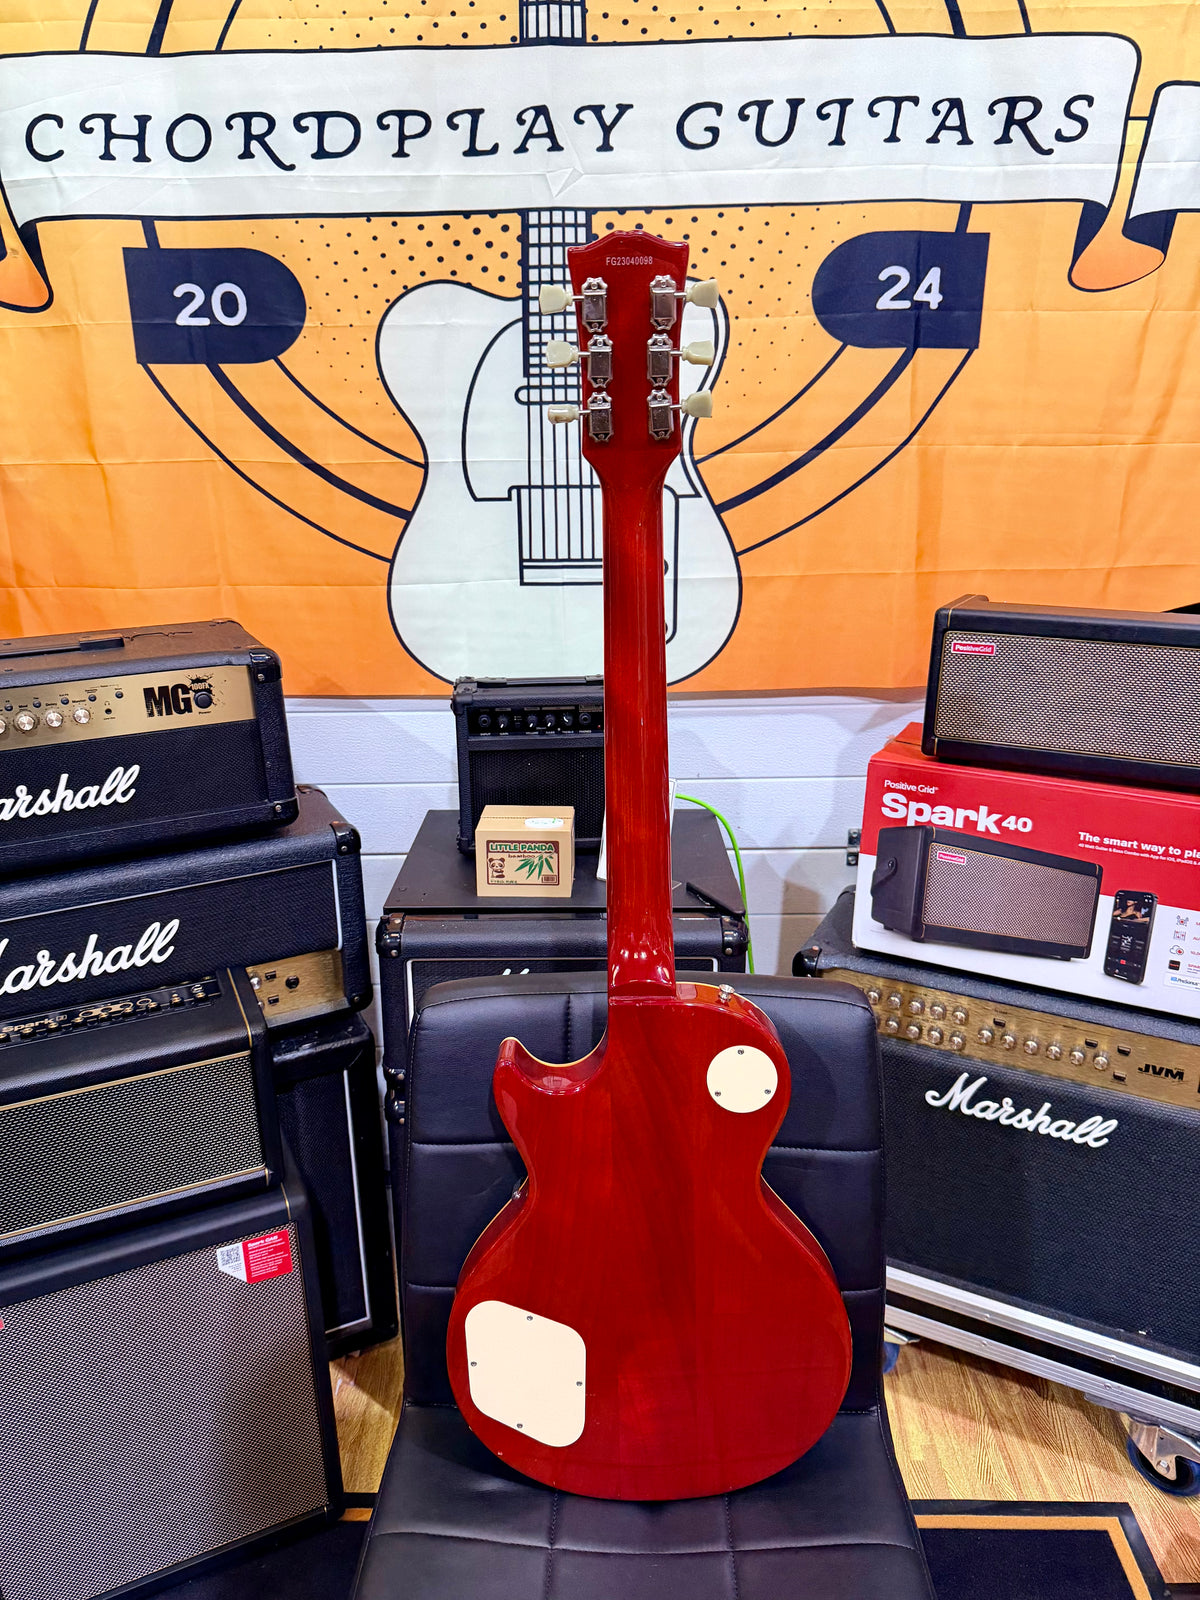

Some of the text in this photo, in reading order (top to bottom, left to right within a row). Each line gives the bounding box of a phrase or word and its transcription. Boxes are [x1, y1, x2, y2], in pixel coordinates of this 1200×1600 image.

[25, 95, 1095, 171] CHORDPLAY GUITARS
[606, 256, 653, 266] FG23040098
[173, 282, 248, 327] 20
[875, 265, 944, 310] 24
[143, 683, 193, 717] MG
[0, 764, 141, 821] arshall
[884, 779, 917, 792] Positive
[881, 792, 1033, 834] Spark 40
[490, 843, 554, 852] LITTLE PANDA
[1078, 831, 1200, 859] The smart way to pla
[2, 1017, 55, 1032] Spark
[1138, 1063, 1185, 1081] JVM
[924, 1072, 1119, 1148] Marshall
